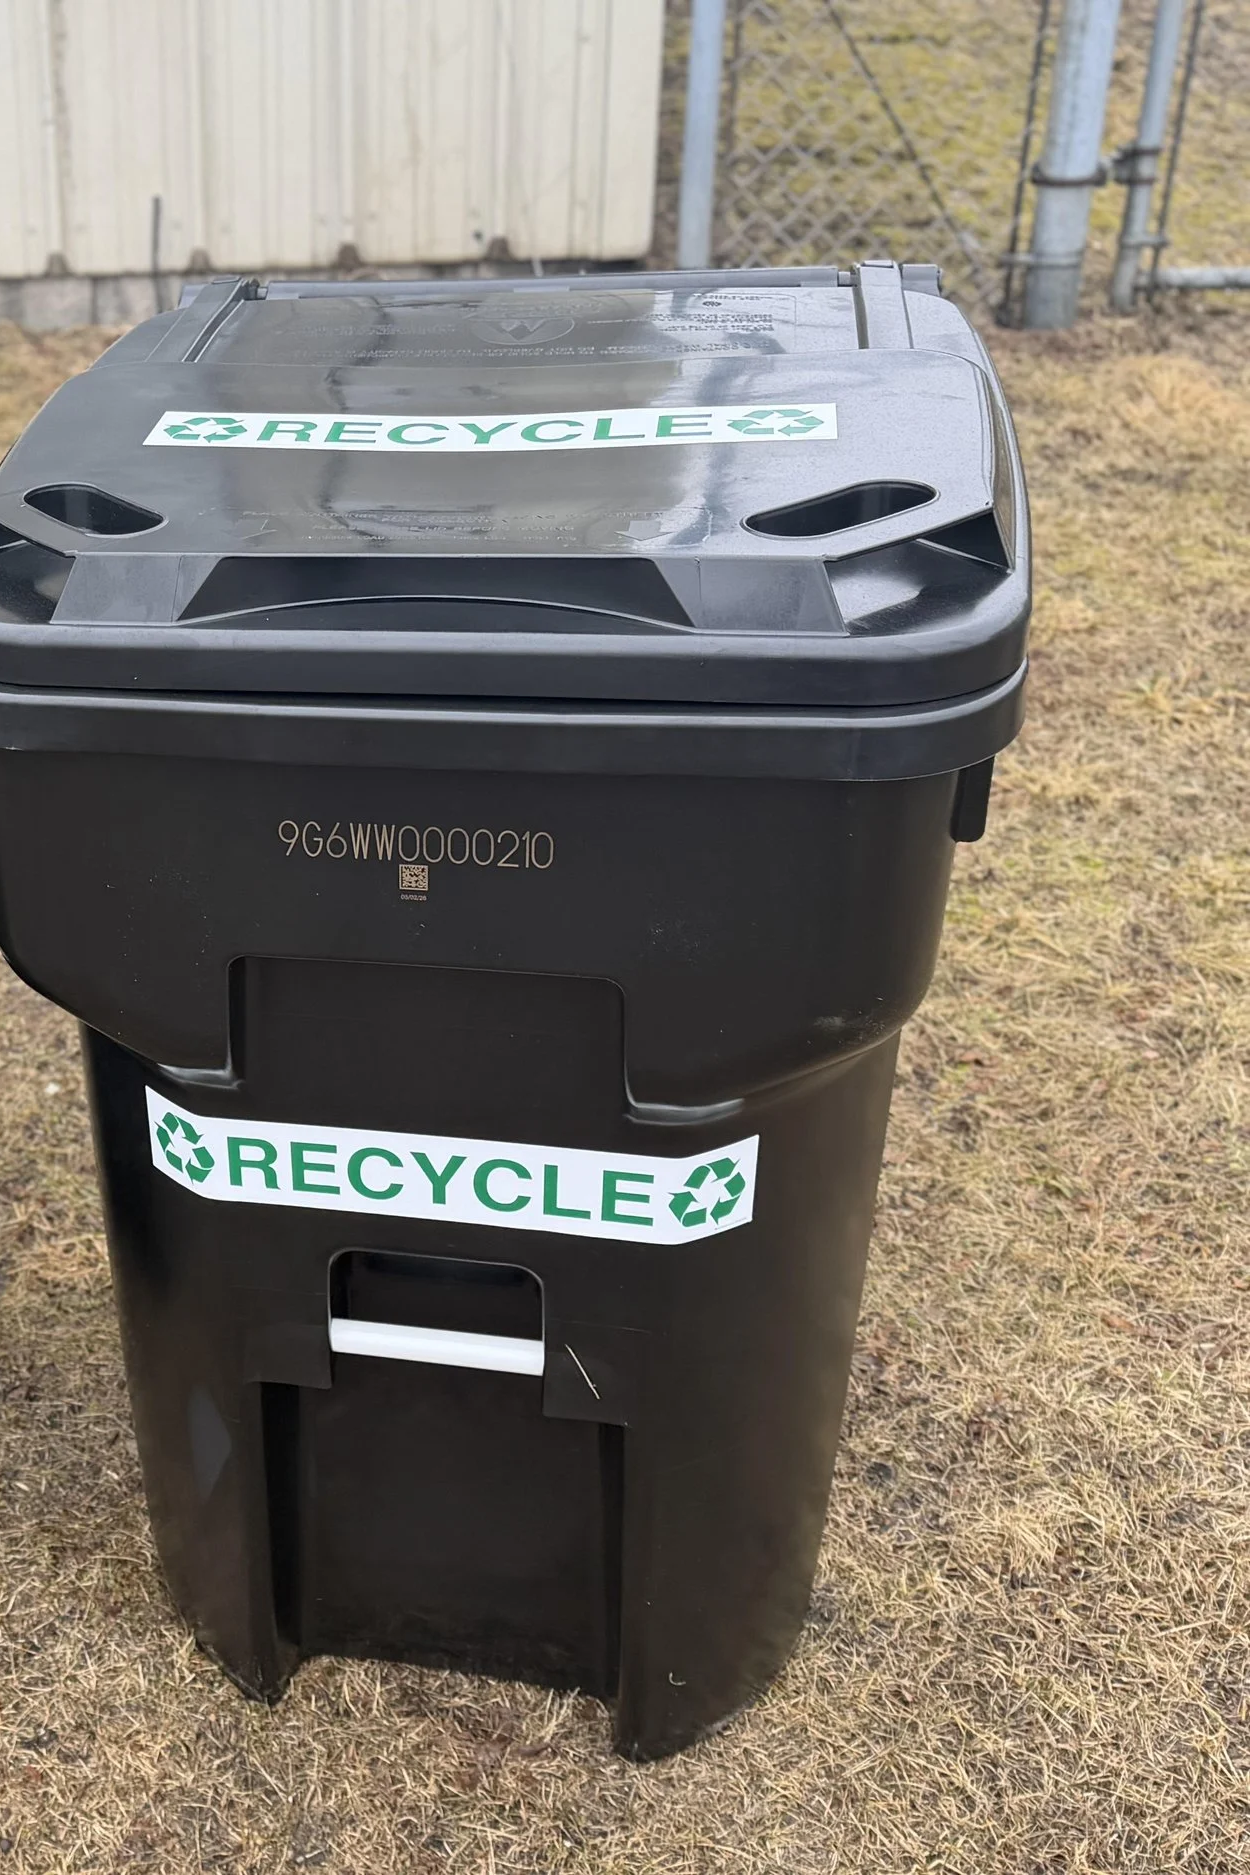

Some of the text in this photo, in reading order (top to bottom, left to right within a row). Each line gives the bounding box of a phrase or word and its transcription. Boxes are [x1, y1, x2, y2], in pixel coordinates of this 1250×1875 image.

[255, 412, 713, 446] RECYCLE
[277, 819, 554, 870] 9G6WW0000210
[226, 1135, 655, 1227] RECYCLE
